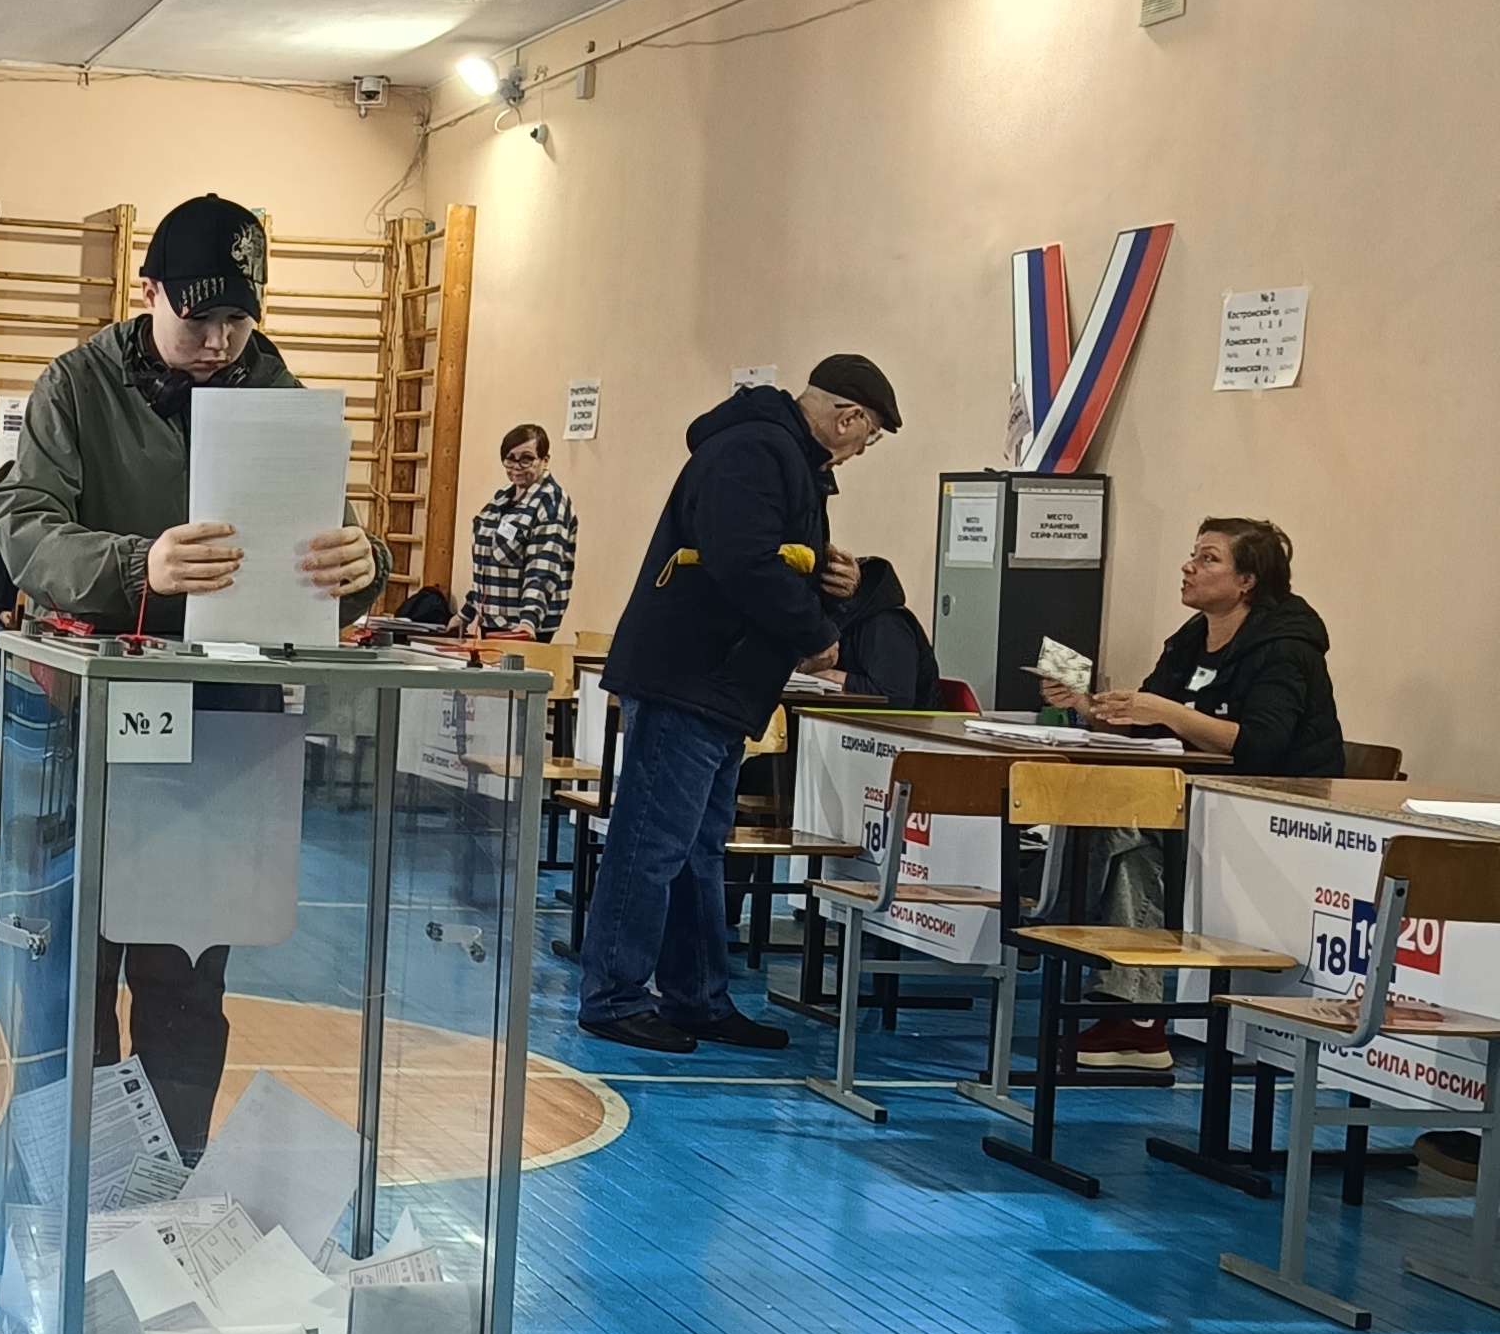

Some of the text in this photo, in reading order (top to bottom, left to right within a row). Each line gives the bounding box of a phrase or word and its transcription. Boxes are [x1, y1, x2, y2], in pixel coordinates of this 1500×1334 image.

[1047, 513, 1073, 521] МЕСТО
[1030, 530, 1088, 540] СЕЙФ-ПАКЕТОВ
[119, 711, 174, 735] № 2
[841, 735, 875, 754] ЕДИНЫЙ
[865, 820, 881, 852] 18
[1270, 816, 1332, 844] ЕДИНЫЙ
[1335, 829, 1377, 853] ДЕНЬ
[1315, 887, 1350, 910] 2026
[890, 904, 956, 938] СИЛА РОССИИ!
[1397, 916, 1440, 955] 20
[1316, 933, 1347, 976] 18
[1366, 1048, 1411, 1078] СИЛА
